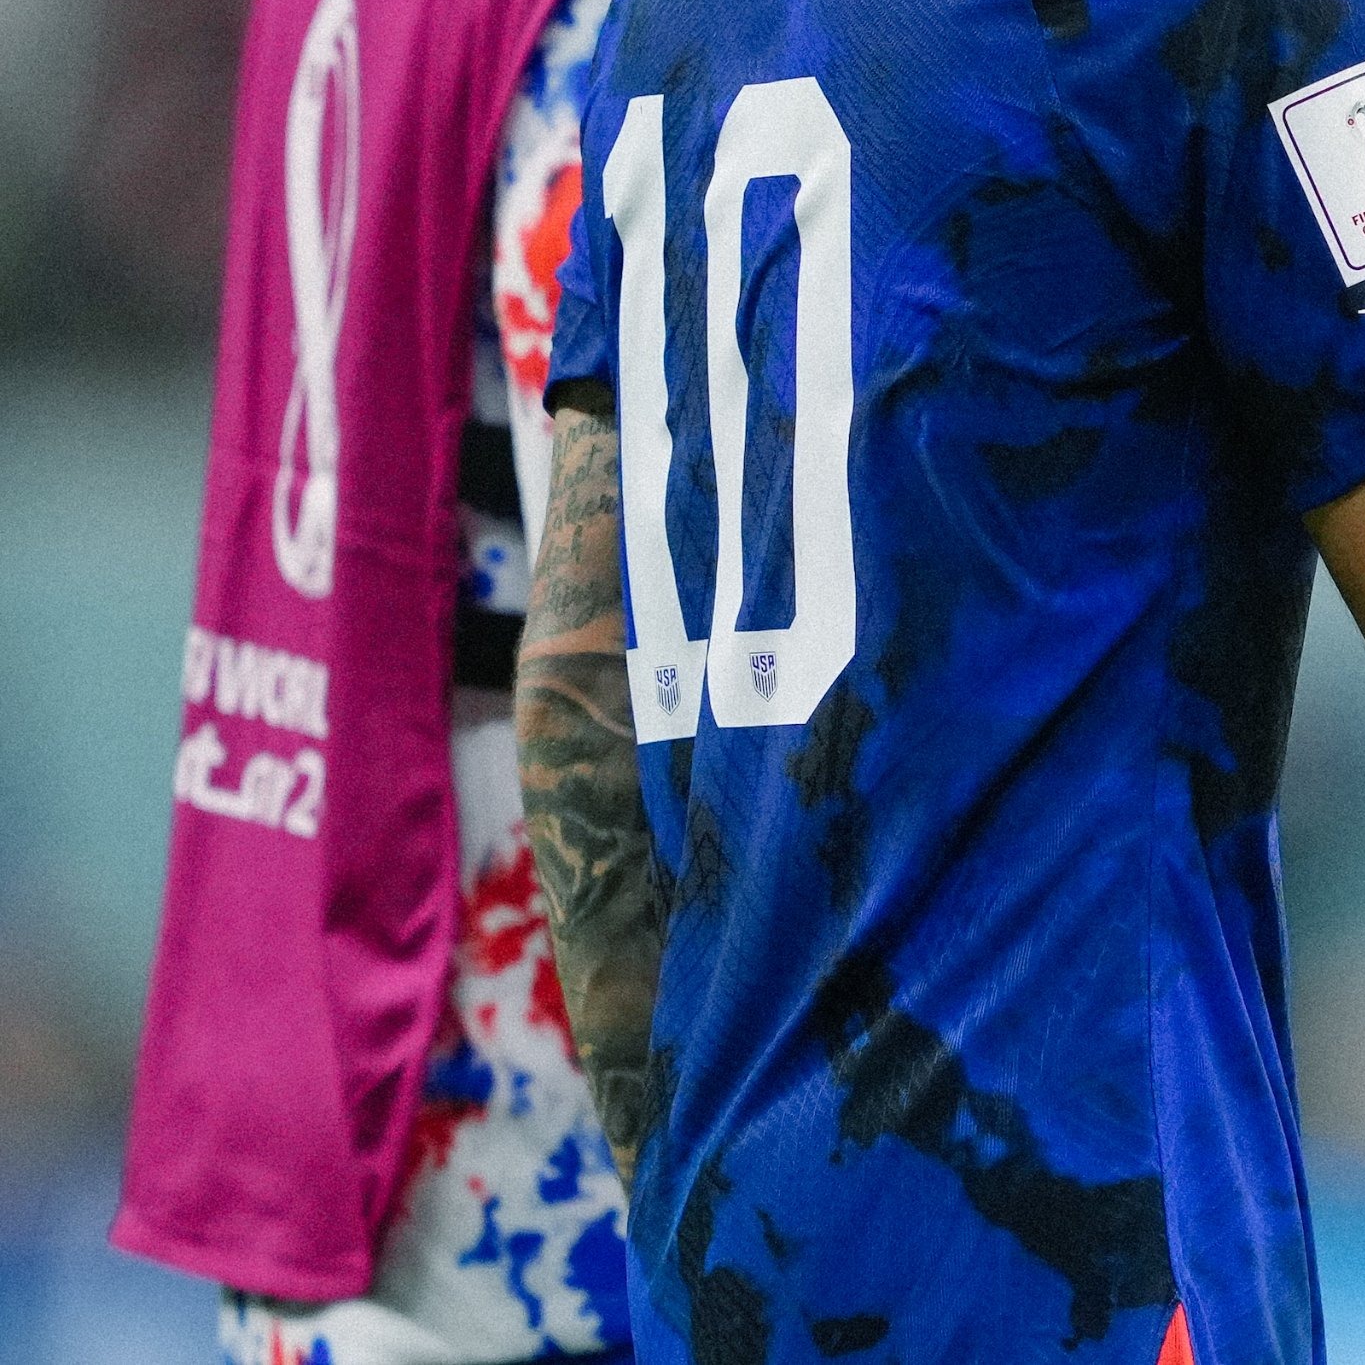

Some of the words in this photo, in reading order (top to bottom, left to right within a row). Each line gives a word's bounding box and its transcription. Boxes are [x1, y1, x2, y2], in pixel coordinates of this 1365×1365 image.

[602, 75, 857, 745] 10
[751, 654, 776, 673] USA
[656, 667, 677, 687] USA
